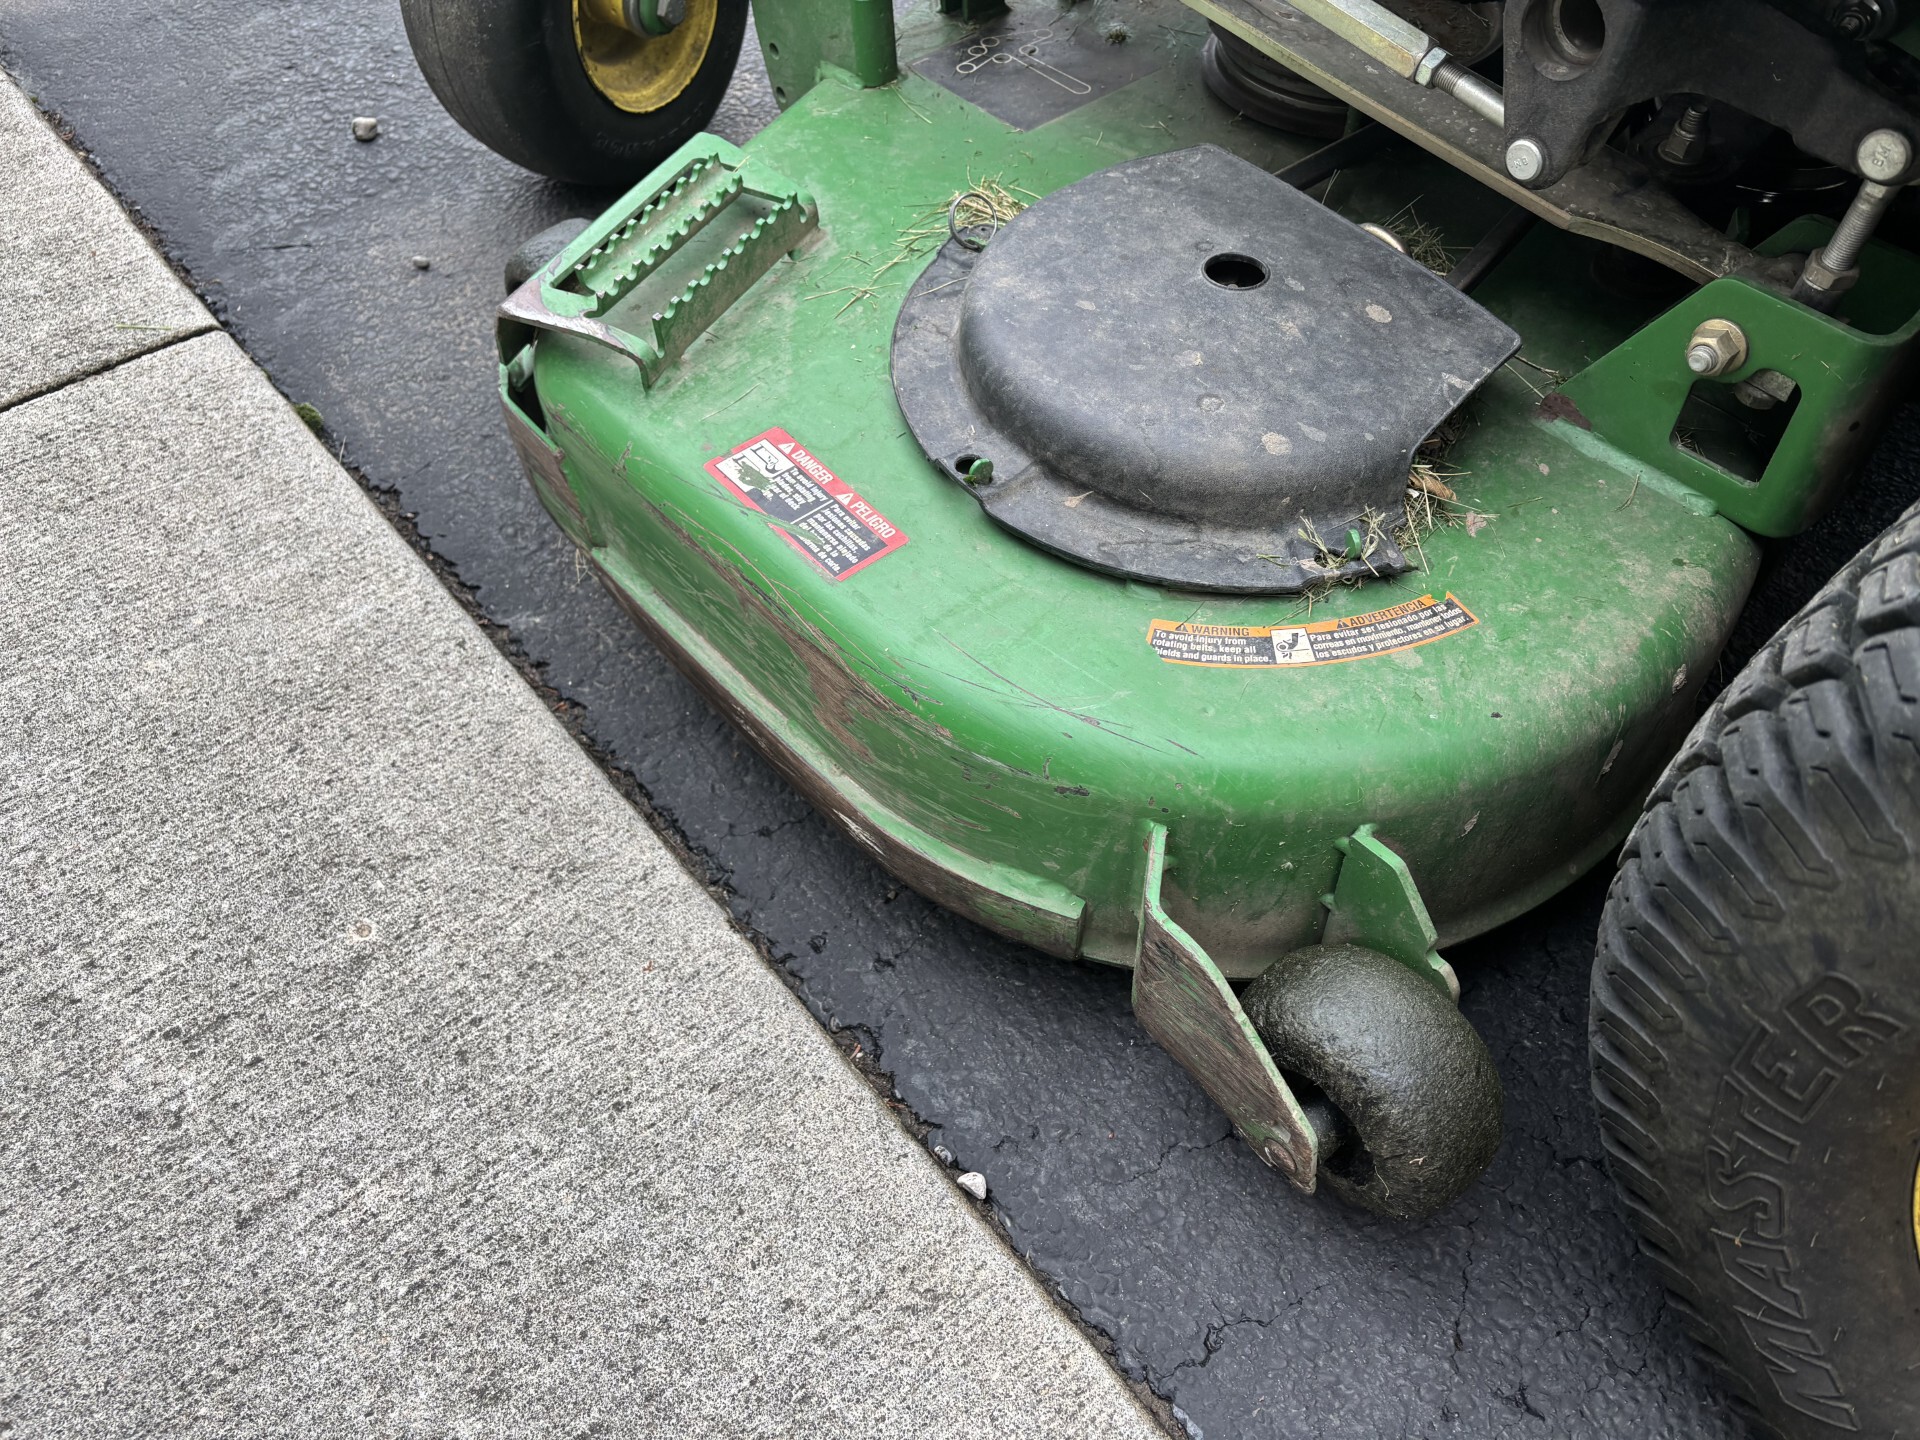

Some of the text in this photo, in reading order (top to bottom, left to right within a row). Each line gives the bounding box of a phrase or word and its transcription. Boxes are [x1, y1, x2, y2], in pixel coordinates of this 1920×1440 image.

[790, 449, 833, 484] DANGER
[781, 472, 815, 503] from rotating
[790, 467, 828, 502] To avoid injury
[792, 492, 806, 505] stay
[784, 497, 799, 510] deck
[830, 503, 861, 530] Para evitar
[812, 513, 825, 523] por
[823, 520, 835, 530] las
[832, 528, 859, 553] cuchillas,
[821, 507, 847, 529] lesiones
[843, 527, 870, 551] causadas
[850, 501, 896, 539] PELIGRO
[806, 517, 838, 546] mantenerse
[836, 544, 858, 564] alejado
[823, 543, 833, 552] de
[830, 549, 838, 557] la
[817, 550, 827, 559] de
[824, 558, 841, 573] corte.
[1310, 633, 1331, 642] Para
[1334, 628, 1359, 639] evitar
[1377, 613, 1418, 630] lesionado
[1420, 608, 1432, 620] por
[1350, 600, 1426, 626] ADVERTENCIA
[1156, 630, 1246, 646] To avoid injury from
[1192, 625, 1249, 636] WARNING
[1313, 608, 1463, 650] correas en movimiento, mantener todos
[1316, 649, 1330, 658] los
[1332, 645, 1368, 656] escudos
[1369, 644, 1374, 652] y
[1376, 631, 1422, 648] protectores
[1445, 616, 1469, 629] lugar.
[1153, 638, 1189, 651] rotating
[1191, 642, 1216, 652] belts,
[1219, 645, 1242, 655] keep
[1155, 648, 1180, 658] hields
[1183, 651, 1199, 659] and
[1201, 653, 1231, 664] guards
[1245, 655, 1272, 664] place.
[1705, 972, 1908, 1431] MASTER
